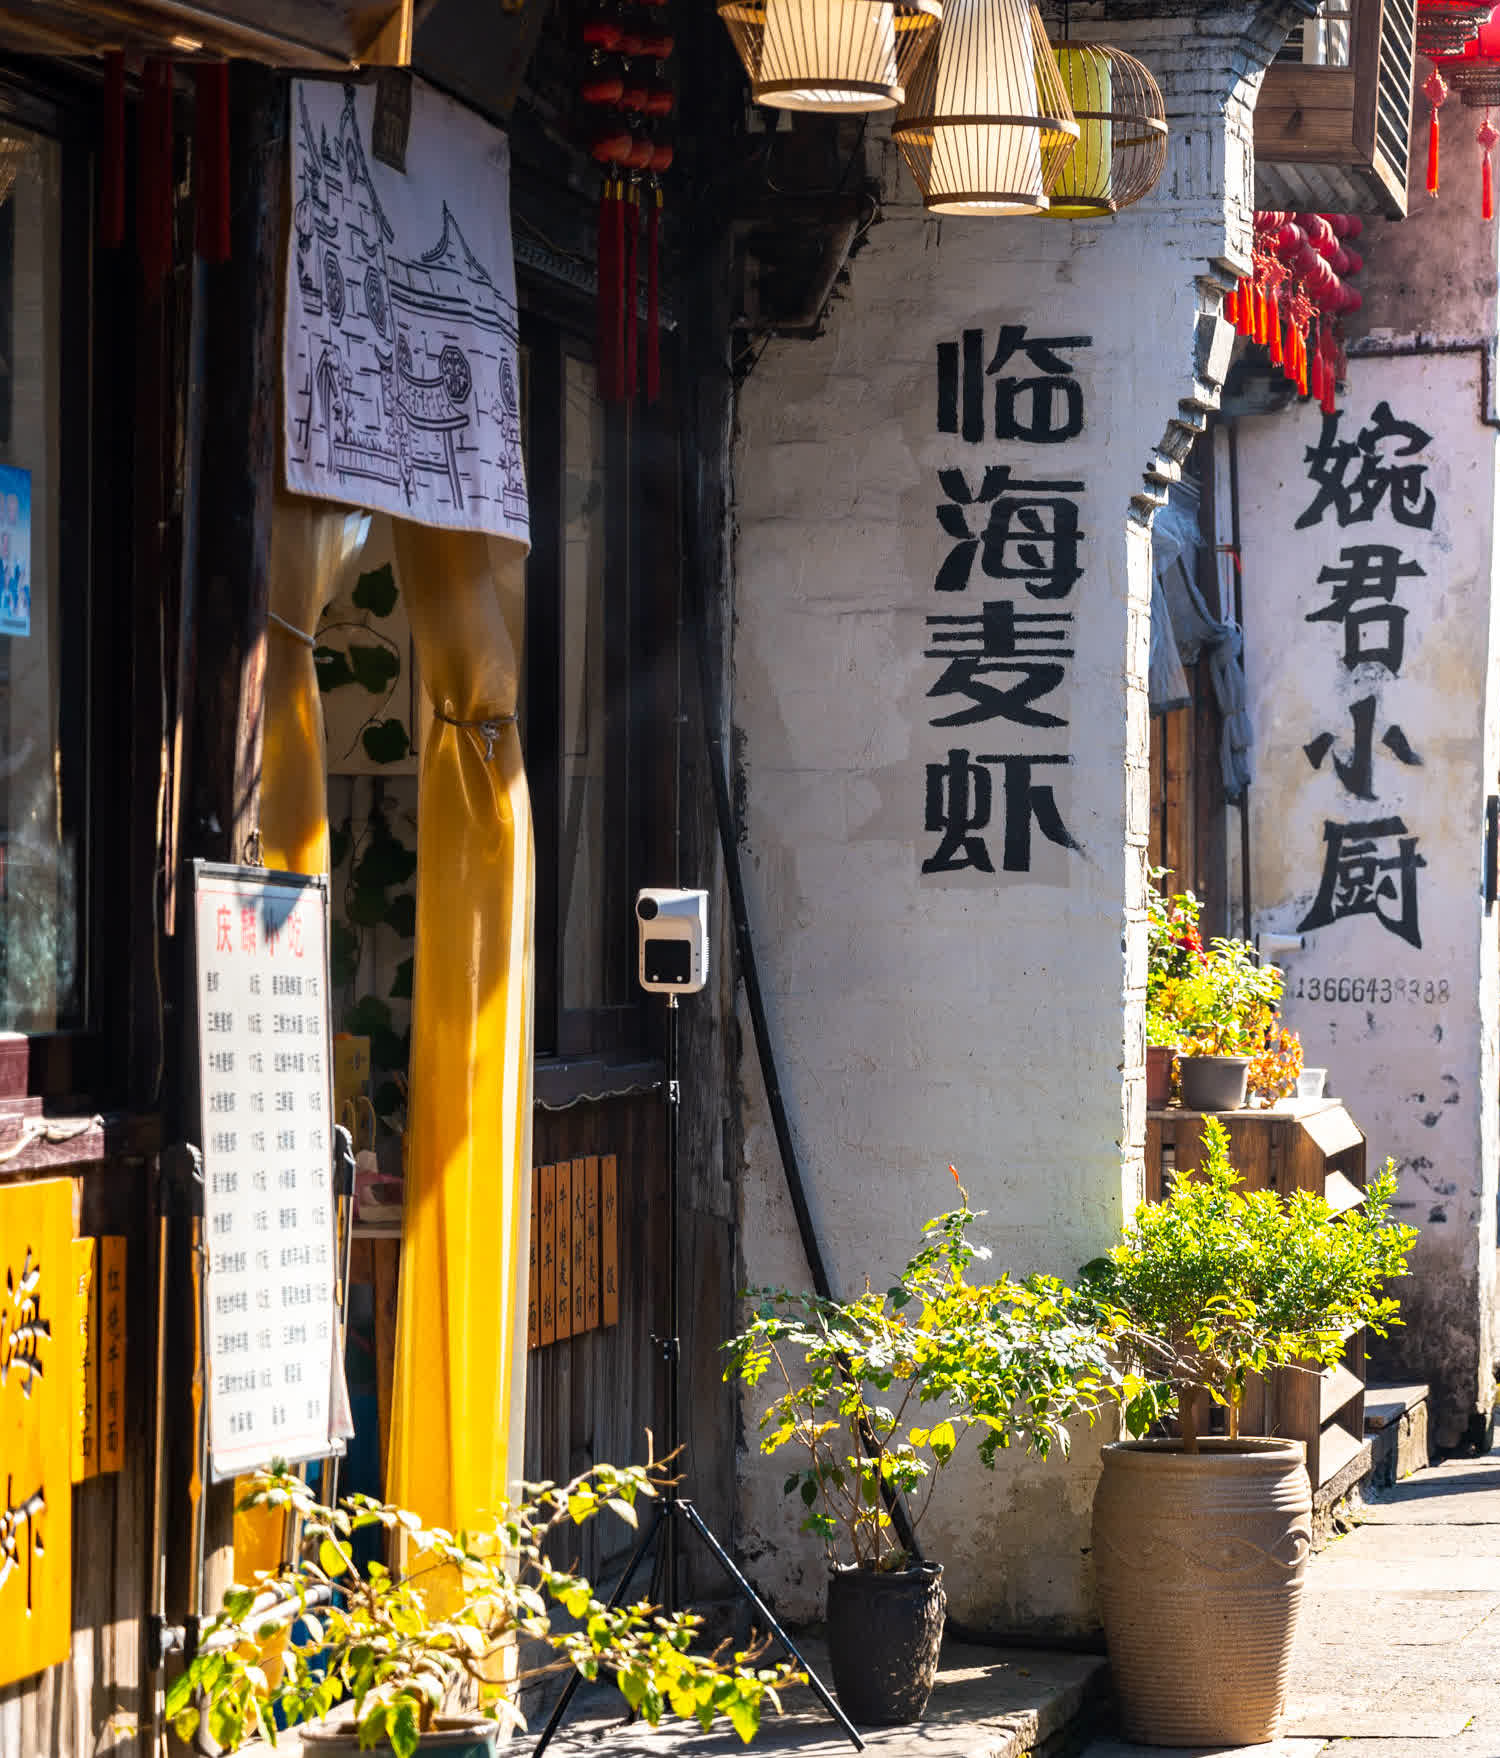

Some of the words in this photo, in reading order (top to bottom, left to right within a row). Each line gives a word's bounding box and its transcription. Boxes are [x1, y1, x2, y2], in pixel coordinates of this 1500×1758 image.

[921, 324, 1094, 875] 临海麦虾
[1294, 400, 1437, 950] 婉君小厨
[106, 1267, 121, 1454] 红烧牛肉面
